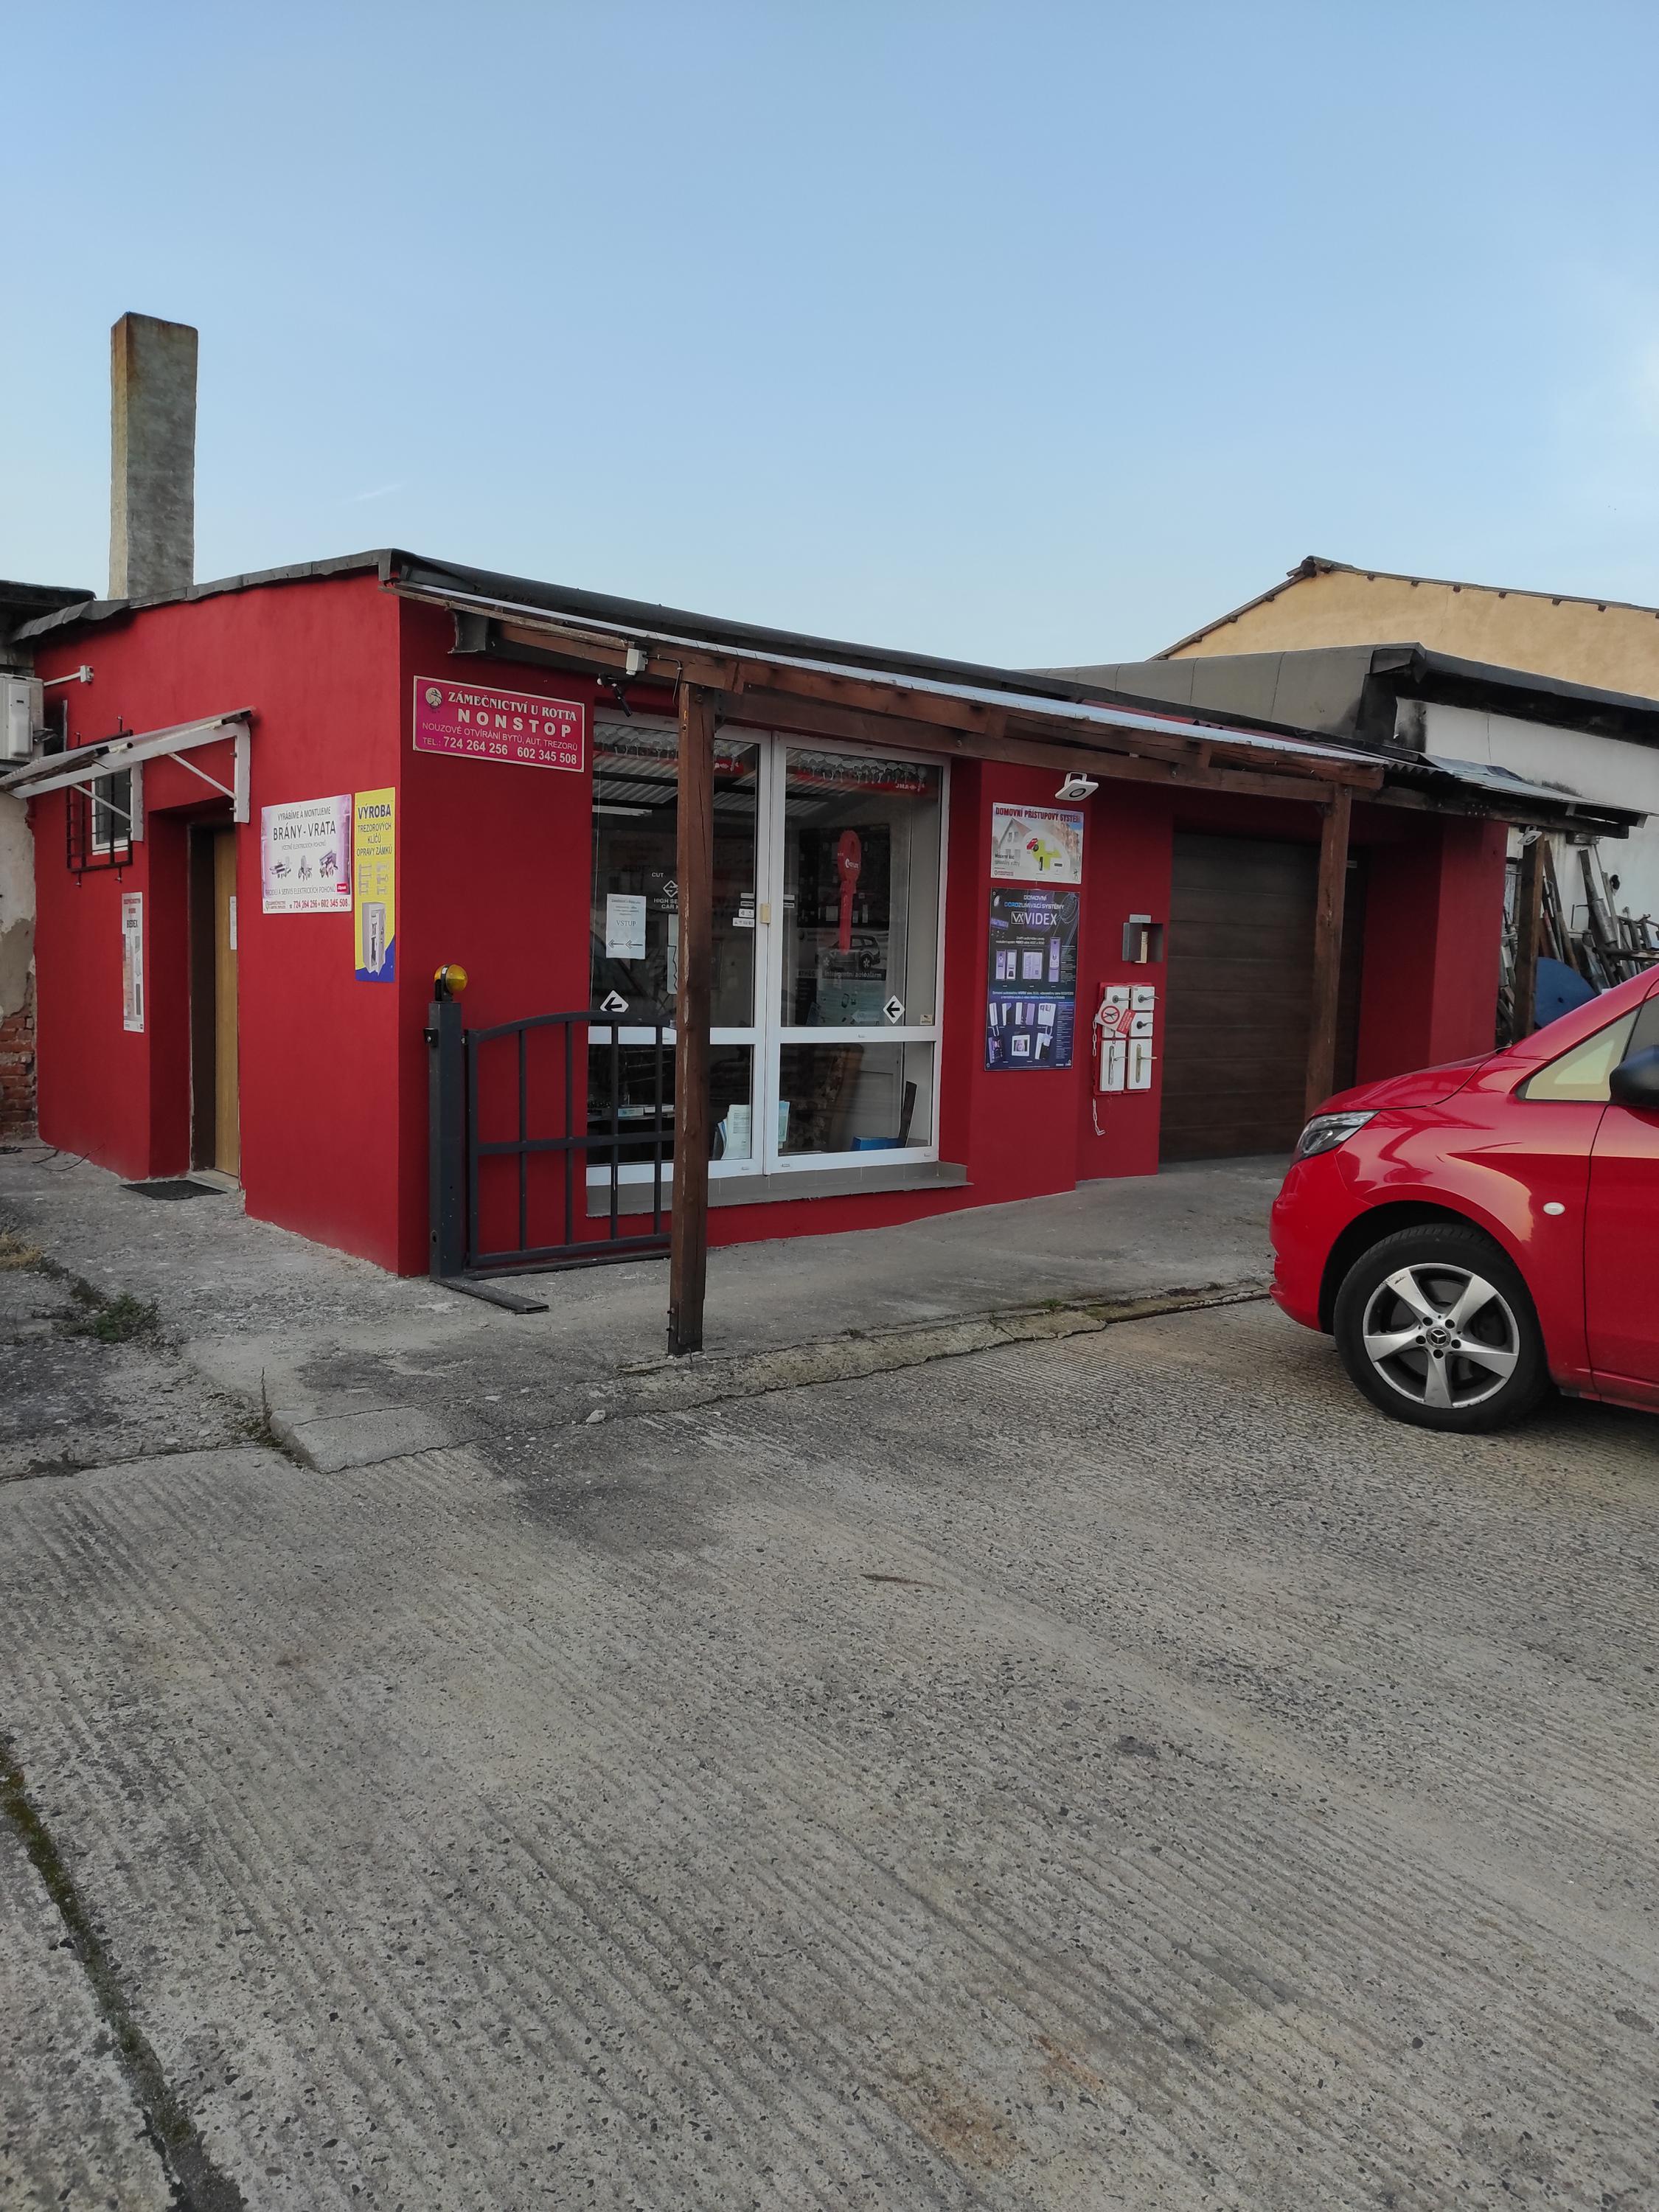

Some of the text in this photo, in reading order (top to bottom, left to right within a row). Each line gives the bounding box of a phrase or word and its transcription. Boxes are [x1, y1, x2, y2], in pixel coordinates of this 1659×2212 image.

[448, 690, 577, 721] ZÁMEČNICTVÍ U ROTTA
[458, 708, 571, 737] NONSTOP
[422, 722, 462, 735] NOUZOVÉ
[464, 728, 501, 740] OTVÍRÁNÍ
[543, 739, 578, 751] TREZORŮ
[422, 736, 577, 765] TEL.: 724 264 256 602 345 508
[277, 806, 331, 821] VYRÁBÍME A MONTUJEME
[358, 803, 392, 819] VÝROBA
[995, 807, 1023, 817] DOMOVNÍ
[273, 822, 302, 841] BRÁNY
[308, 820, 336, 837] VRATA
[358, 821, 392, 833] TREZOROVÝCH
[356, 846, 375, 857] OPRAVY
[310, 900, 318, 908] 256
[321, 899, 329, 908] 602
[330, 898, 338, 907] 345
[339, 898, 348, 907] 508
[1025, 912, 1057, 926] VIDEX
